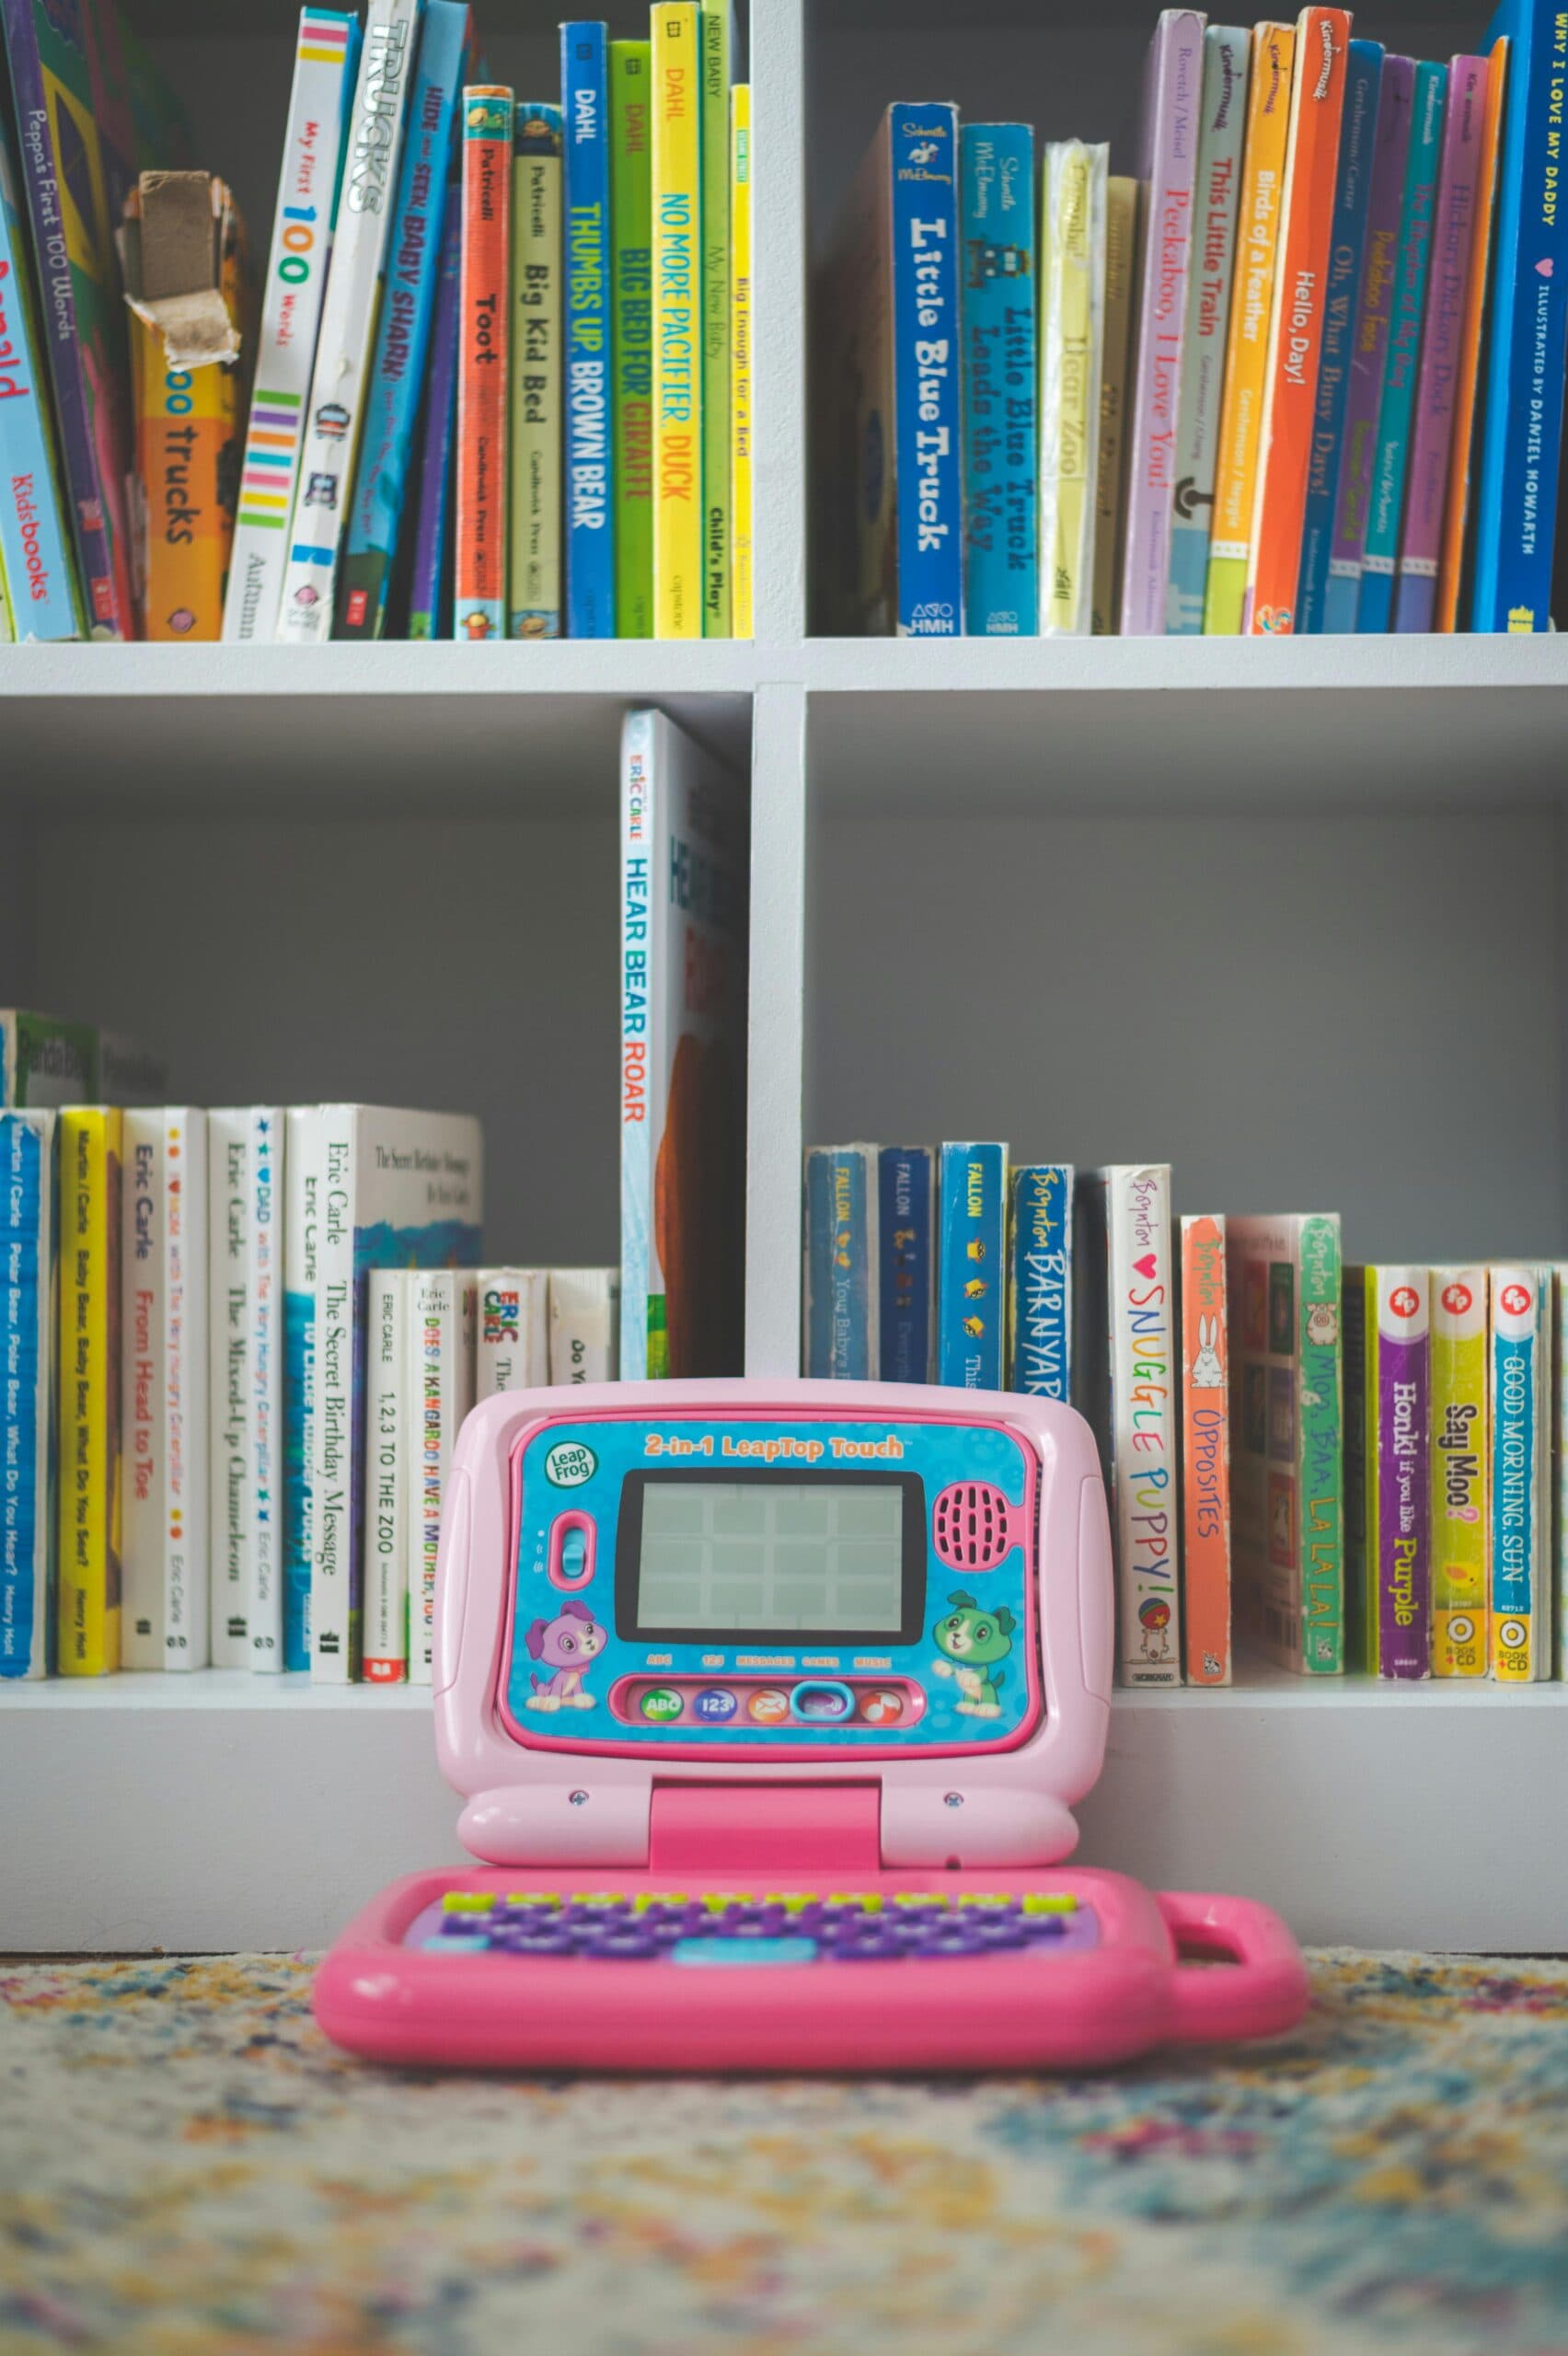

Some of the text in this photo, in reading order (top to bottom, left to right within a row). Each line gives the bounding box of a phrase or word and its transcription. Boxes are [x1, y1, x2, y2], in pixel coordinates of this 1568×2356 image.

[665, 68, 686, 122] DAHL
[706, 16, 721, 99] NEW BABY
[1211, 43, 1243, 133] Kindermusik
[1262, 43, 1288, 117] Kindermusik
[1311, 20, 1341, 102] Kindermusik
[347, 19, 410, 216] TRUCKS
[574, 89, 597, 144] DAHL
[625, 103, 648, 157] DAHL
[1541, 13, 1568, 226] WHY I LOVE MY DADDY
[25, 109, 75, 341] Peppa's First 100 Words
[480, 148, 495, 222] Patricelli
[530, 166, 545, 237] Patricelli
[275, 121, 319, 347] My First 100 Words
[381, 86, 444, 383] HIDE BABY SHARK!
[1197, 156, 1234, 337] This Little Train
[1243, 169, 1275, 342] Birds of a Feather
[475, 293, 498, 364] Toot
[520, 264, 550, 424] Big Kid Bed
[660, 193, 694, 502] NO MORE PACIFIER, DUCK
[704, 246, 727, 360] My New Baby
[1147, 188, 1191, 489] Peekaboo, I Love You!
[1283, 270, 1316, 387] Hello, Day!
[569, 201, 606, 531] THUMBS UP, BROWN BEAR
[618, 247, 652, 502] BIG BED FOR GIRAFFE
[732, 277, 751, 457] Big Enough for Bed
[910, 217, 951, 552] Little Blue Truck
[1060, 335, 1088, 477] Dear Zoo
[1309, 244, 1355, 498] Oh, What Busy Days!
[967, 326, 1004, 552] Leads the Way
[1004, 306, 1035, 572] Little Blue Truck
[1522, 284, 1551, 555] ILLUSTRATED BY DANIEL HOWARTH
[164, 425, 201, 546] trucks
[12, 473, 48, 601] Kidsbooks
[706, 507, 725, 611] Child's Play
[238, 552, 268, 640] Autumn
[910, 618, 954, 634] HMH
[628, 754, 643, 840] ERIC CARLE
[623, 858, 649, 1124] HEAR BEAR ROAR
[835, 1167, 851, 1222] FALLON
[895, 1162, 911, 1217] FALLON
[966, 1162, 984, 1218] FALLON
[1026, 1168, 1060, 1249] Boynton
[1127, 1178, 1159, 1247] Boynton
[418, 1300, 450, 1311] Carle
[1193, 1238, 1223, 1307] Boynton
[1306, 1223, 1333, 1296] Boynton
[135, 1144, 154, 1501] Eric Carle From Head to Toe
[228, 1142, 247, 1582] Eric Carle The Chameleon
[315, 1141, 350, 1576] Eric Carle The Secret Birthday Message
[381, 1324, 394, 1364] CARLE
[422, 1376, 442, 1461] KANGAROO
[1503, 1355, 1526, 1415] GOOD
[378, 1443, 396, 1466] TO
[551, 1448, 586, 1467] Leap
[555, 1461, 590, 1481] Frog
[644, 1434, 905, 1462] 2-in-1 LeapTop Touch
[1127, 1285, 1175, 1593] SNUGGLE PUPPY!
[1193, 1409, 1226, 1539] OPPOSITES
[1437, 1404, 1481, 1524] Say Moo?
[1501, 1420, 1525, 1530] MORNING,
[377, 1516, 395, 1554] ZOO
[378, 1473, 396, 1507] THE
[1309, 1353, 1341, 1629] MOO, BAA, LA LA LA!
[1388, 1381, 1419, 1627] Honk! if you like Purple
[1502, 1535, 1525, 1583] SUN
[647, 1655, 672, 1666] ABC
[1498, 1650, 1528, 1660] BOOK
[646, 1697, 731, 1712] ABC 123
